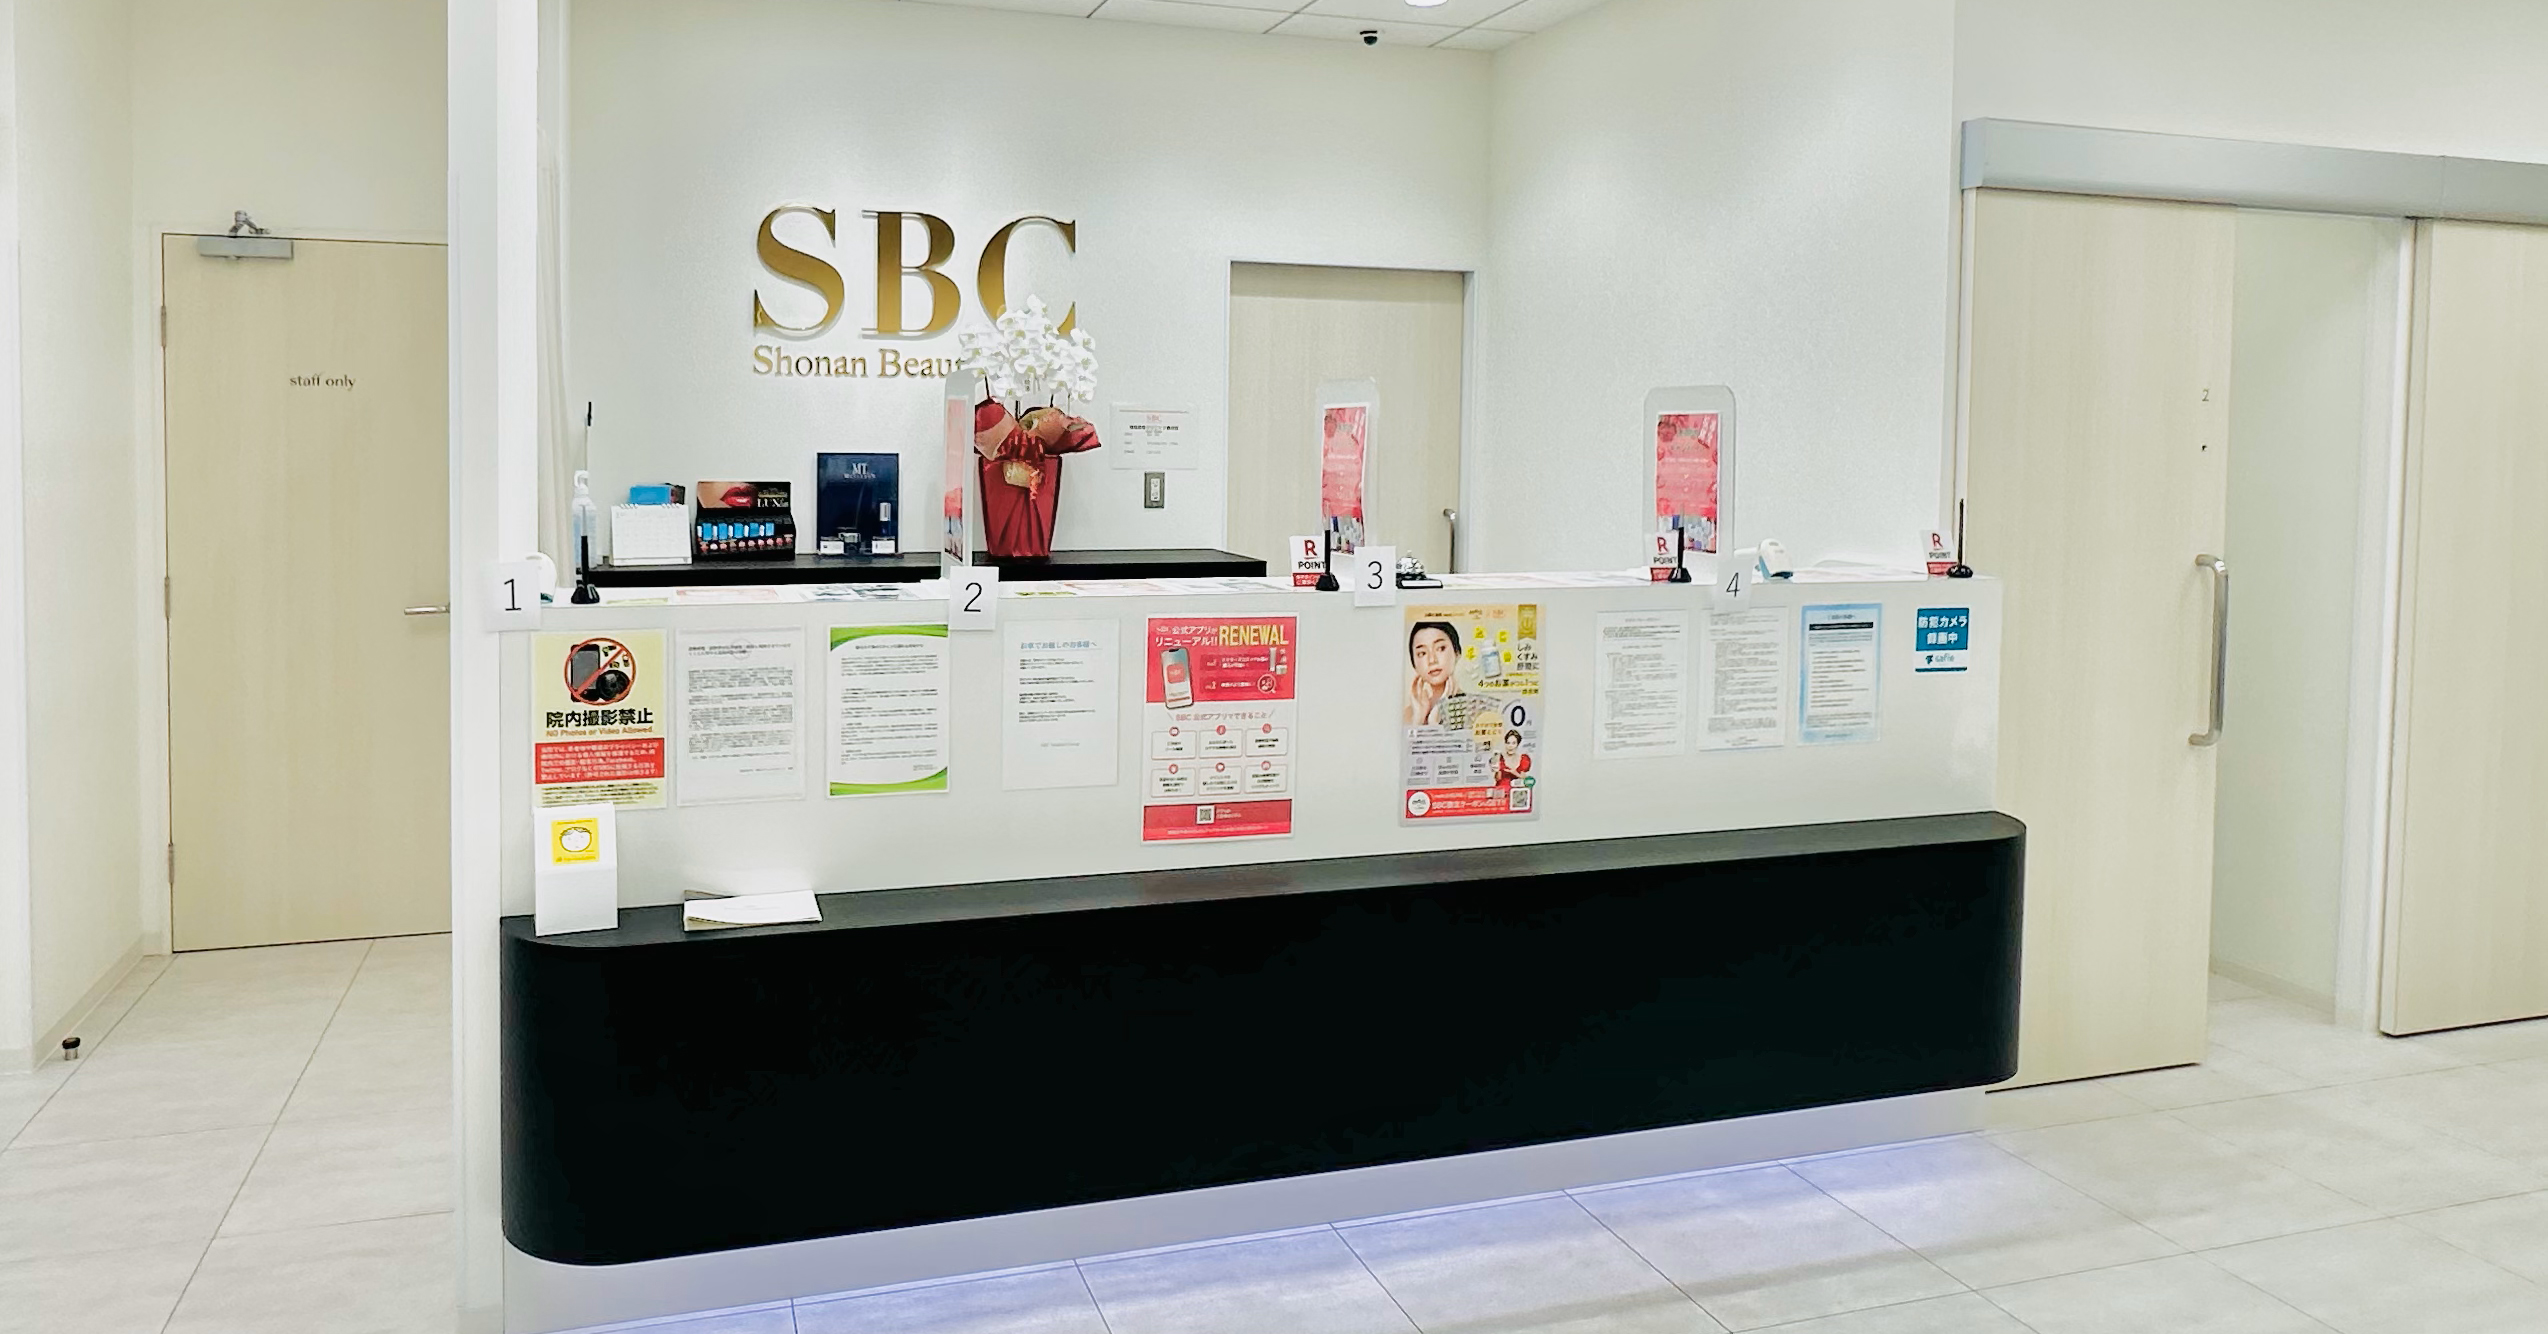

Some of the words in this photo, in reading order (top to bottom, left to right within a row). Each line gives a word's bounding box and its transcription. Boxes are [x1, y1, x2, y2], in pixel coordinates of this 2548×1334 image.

[754, 205, 1076, 339] SBC
[753, 345, 868, 378] Shonan
[290, 374, 324, 387] staff
[325, 374, 356, 391] only
[2202, 388, 2209, 402] 2
[1304, 540, 1317, 556] R
[1657, 537, 1669, 552] R
[1932, 533, 1943, 549] R
[1367, 561, 1383, 590] 3
[1726, 572, 1741, 598] 4
[504, 579, 522, 611] 1
[963, 582, 982, 612] 2
[1218, 625, 1289, 646] RENEWAL
[546, 707, 654, 728] 院内撮影禁止
